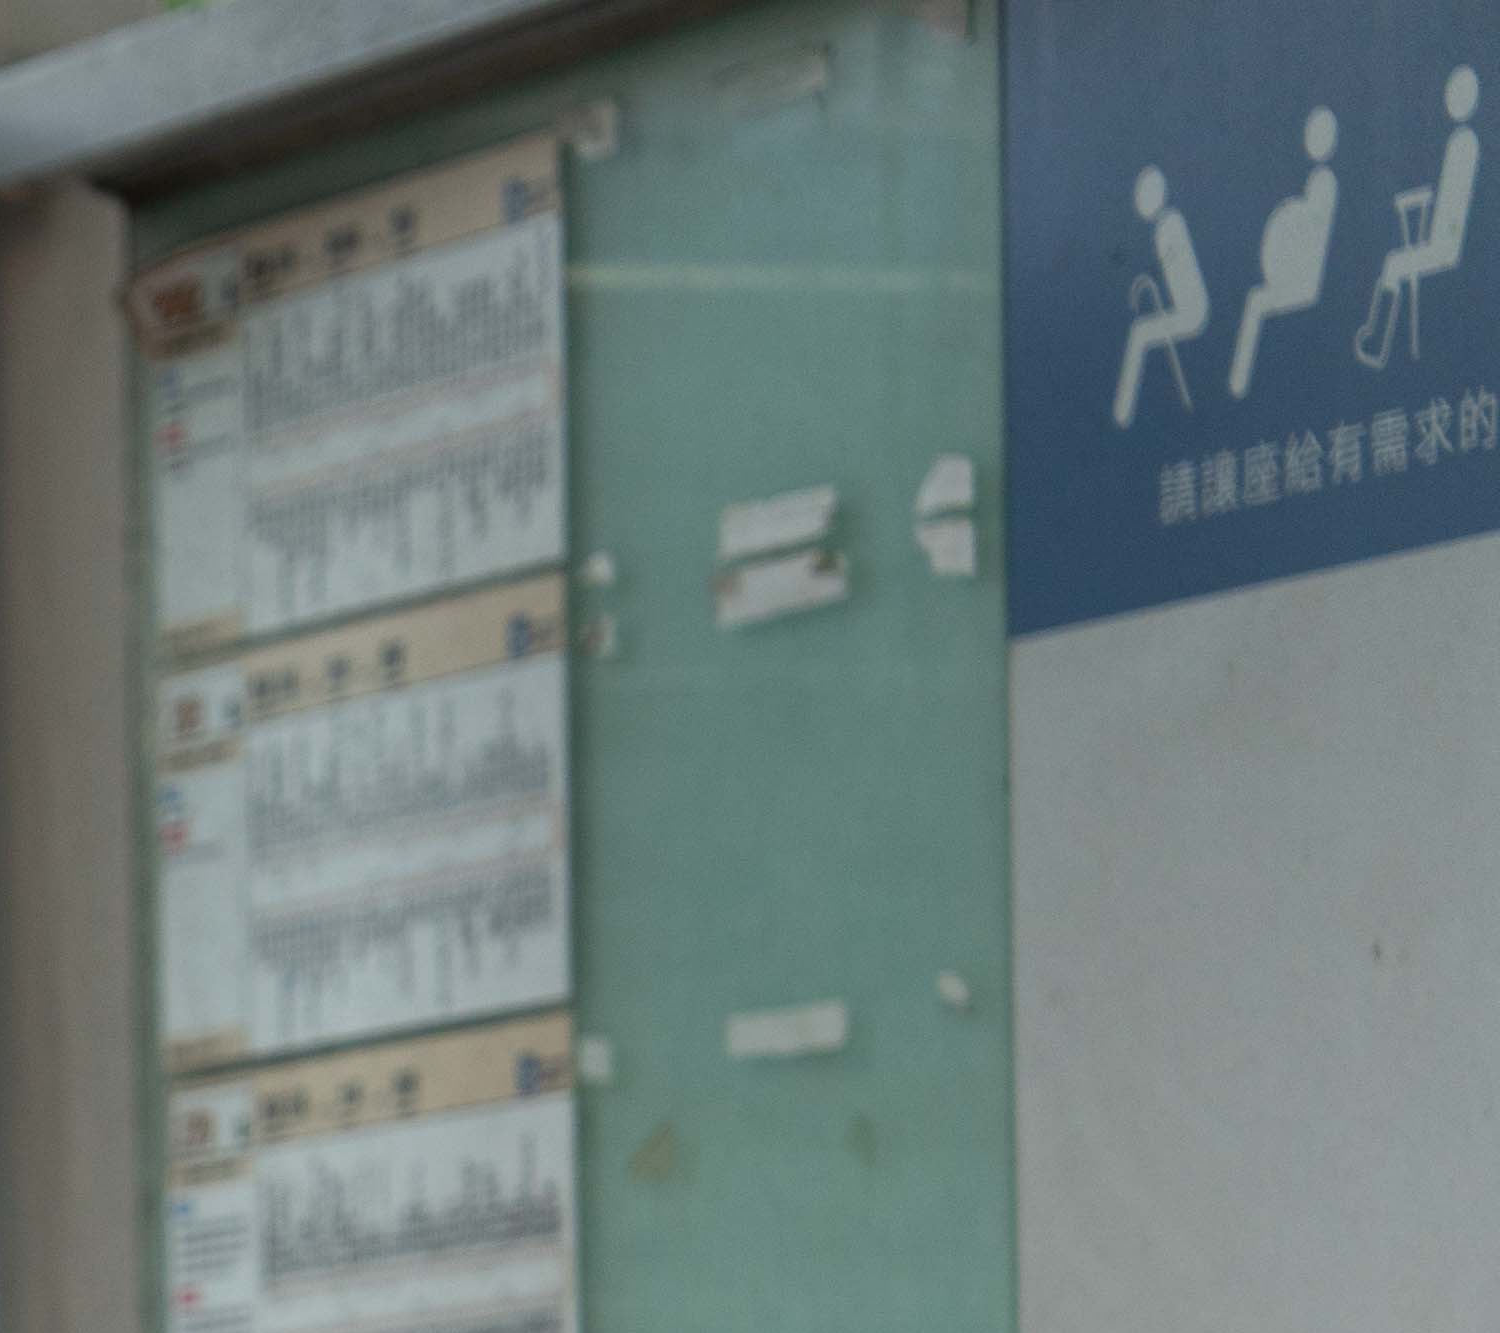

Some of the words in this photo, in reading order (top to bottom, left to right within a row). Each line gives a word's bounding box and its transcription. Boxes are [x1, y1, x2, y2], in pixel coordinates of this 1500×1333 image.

[1156, 384, 1498, 526] 請讓座給有需求的
